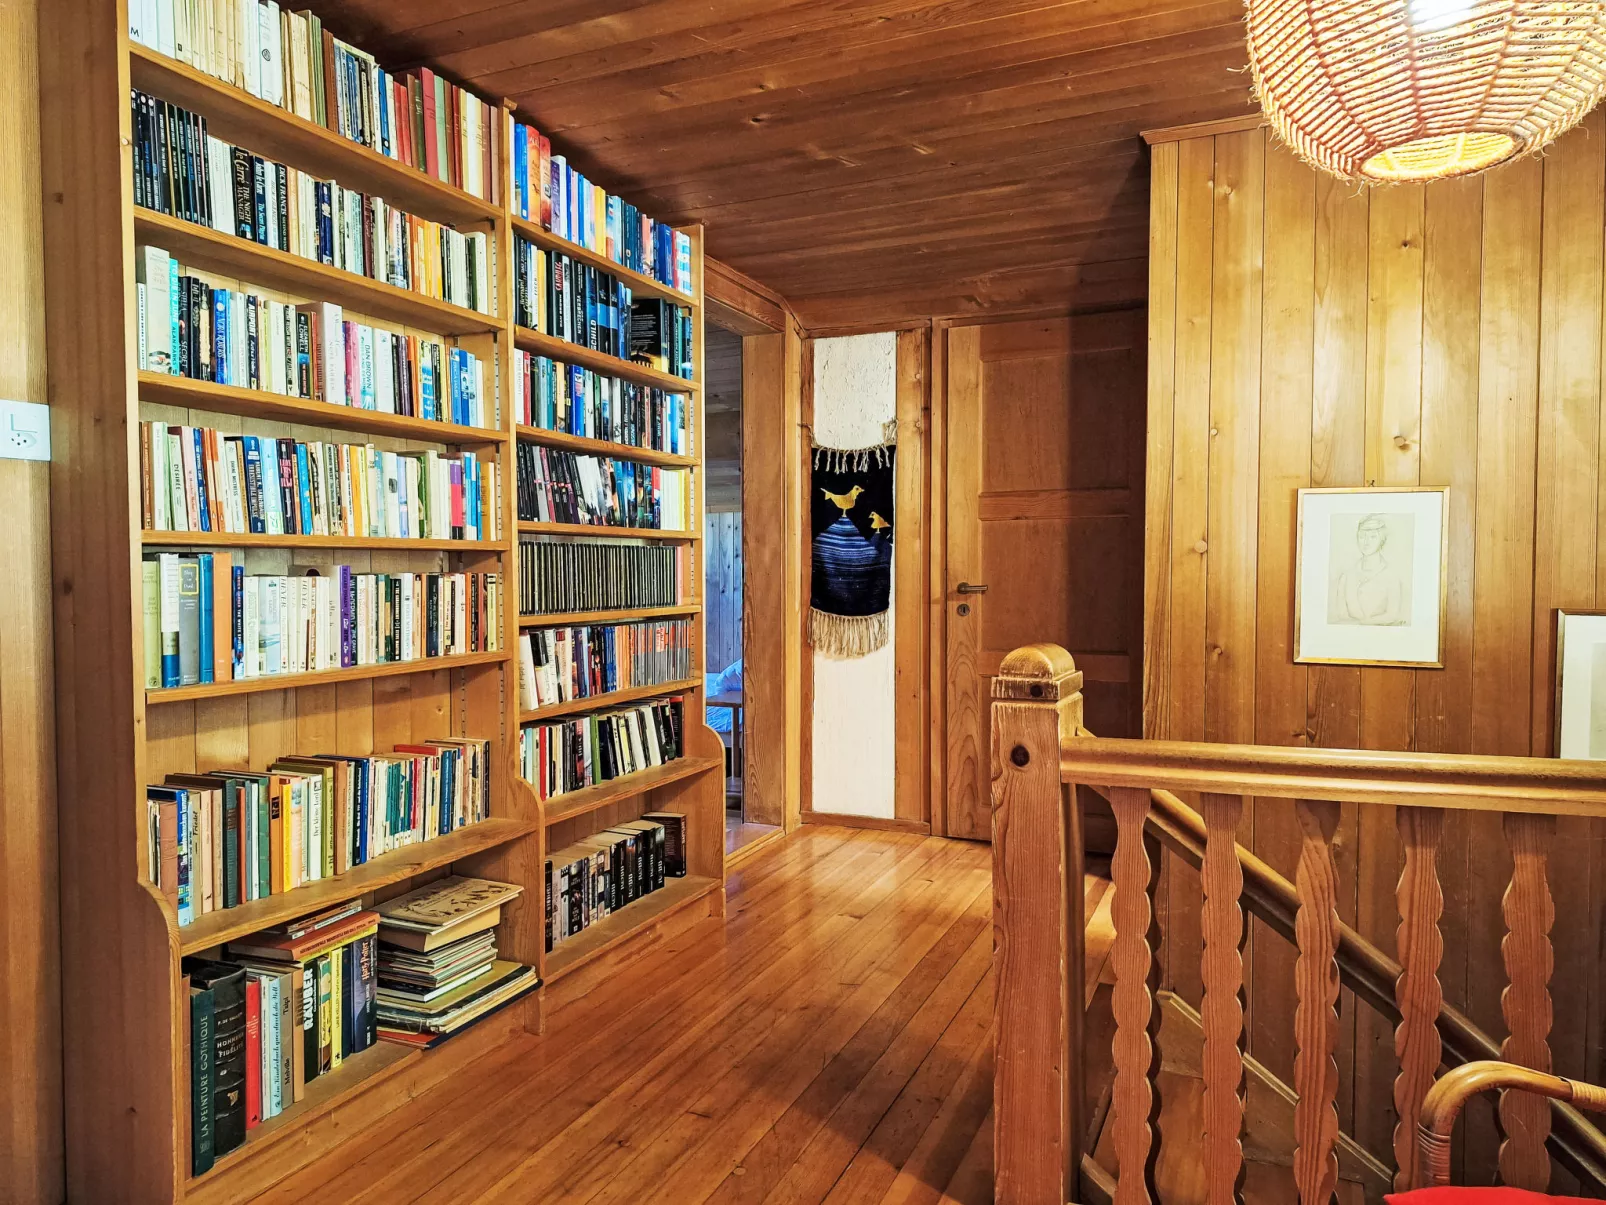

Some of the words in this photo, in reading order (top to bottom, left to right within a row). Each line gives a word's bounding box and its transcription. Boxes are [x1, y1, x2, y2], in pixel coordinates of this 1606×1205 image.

[236, 150, 248, 159] le
[234, 159, 250, 184] Carré
[236, 185, 244, 221] MANAGER
[242, 186, 250, 200] THE
[244, 200, 252, 224] NIGHT
[180, 290, 188, 311] STELLA
[248, 304, 257, 338] AIRPORT
[359, 942, 369, 962] Potter
[360, 963, 370, 980] Harry
[282, 996, 290, 1015] Taipi
[304, 968, 314, 1030] RÄUBER
[272, 1011, 280, 1031] durch
[200, 1014, 208, 1071] GOTHIQUE
[272, 1046, 280, 1084] Kinderbuch
[200, 1073, 208, 1122] PEINTURE
[201, 1124, 209, 1138] LA
